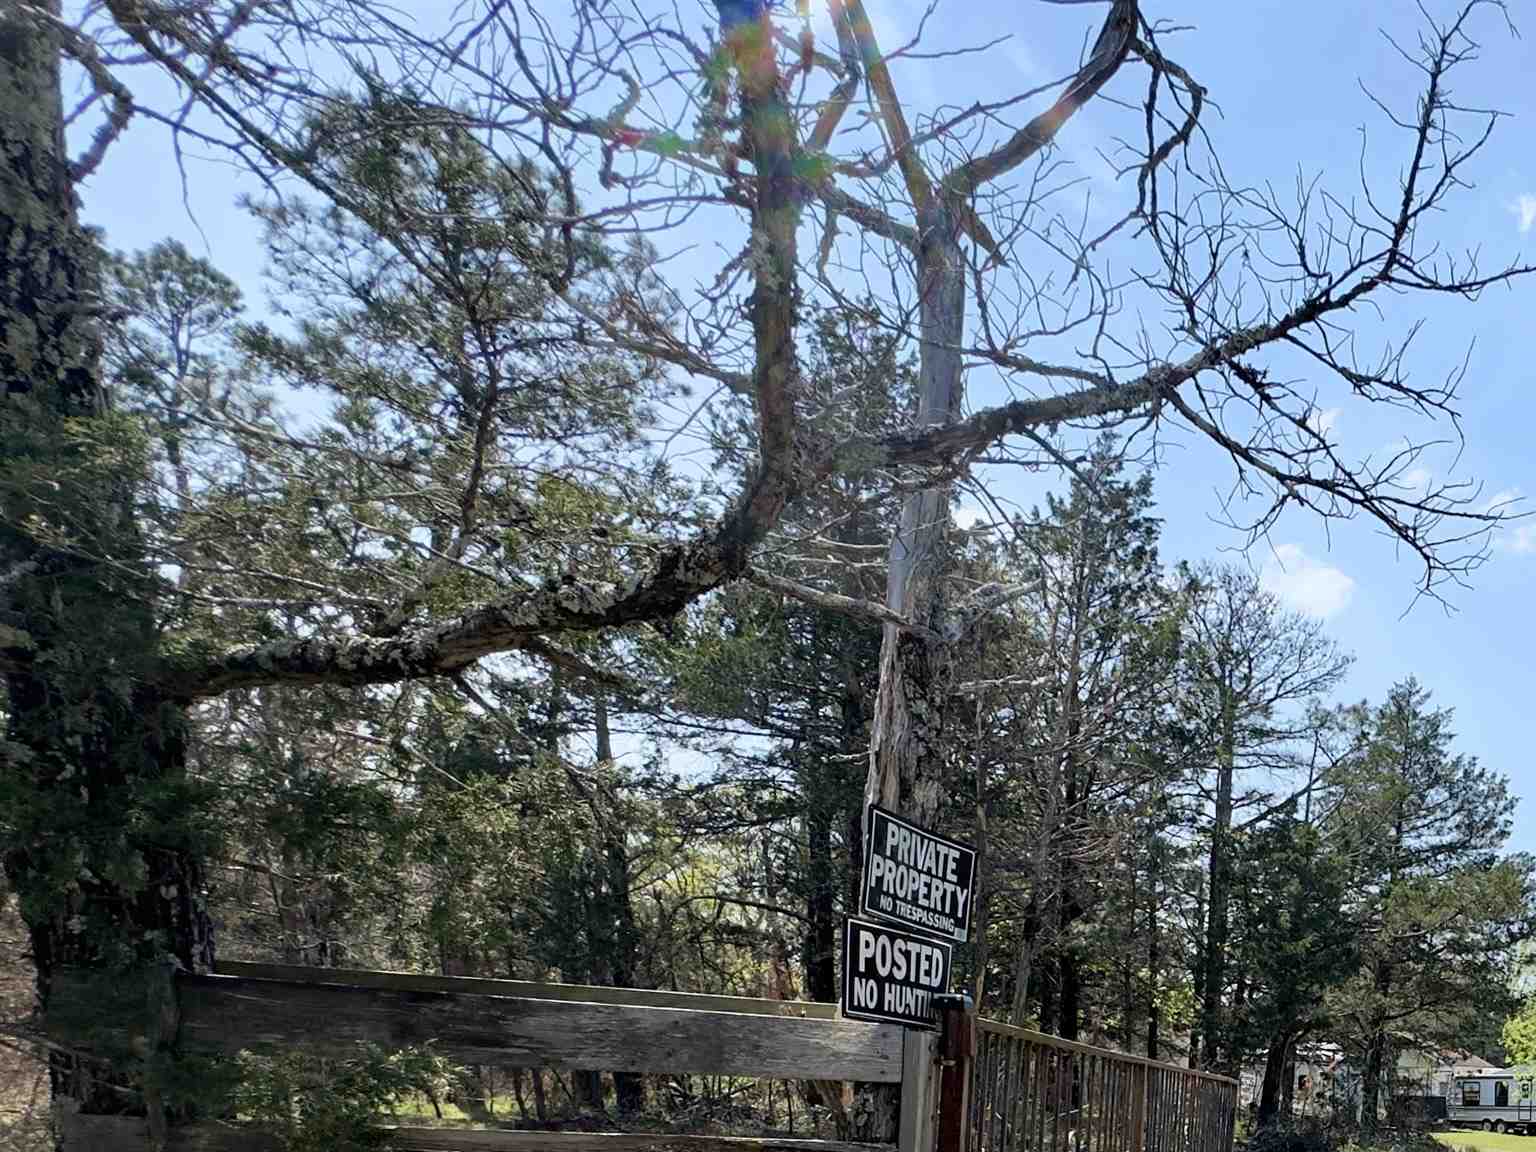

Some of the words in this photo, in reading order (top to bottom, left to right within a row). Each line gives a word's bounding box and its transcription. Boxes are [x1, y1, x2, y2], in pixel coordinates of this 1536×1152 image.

[885, 821, 961, 884] PRIVATE
[870, 853, 968, 919] PROPERTY
[879, 893, 893, 912] NO
[895, 900, 955, 933] TRESPASSING
[858, 929, 944, 989] POSTED
[853, 976, 878, 1010] NO
